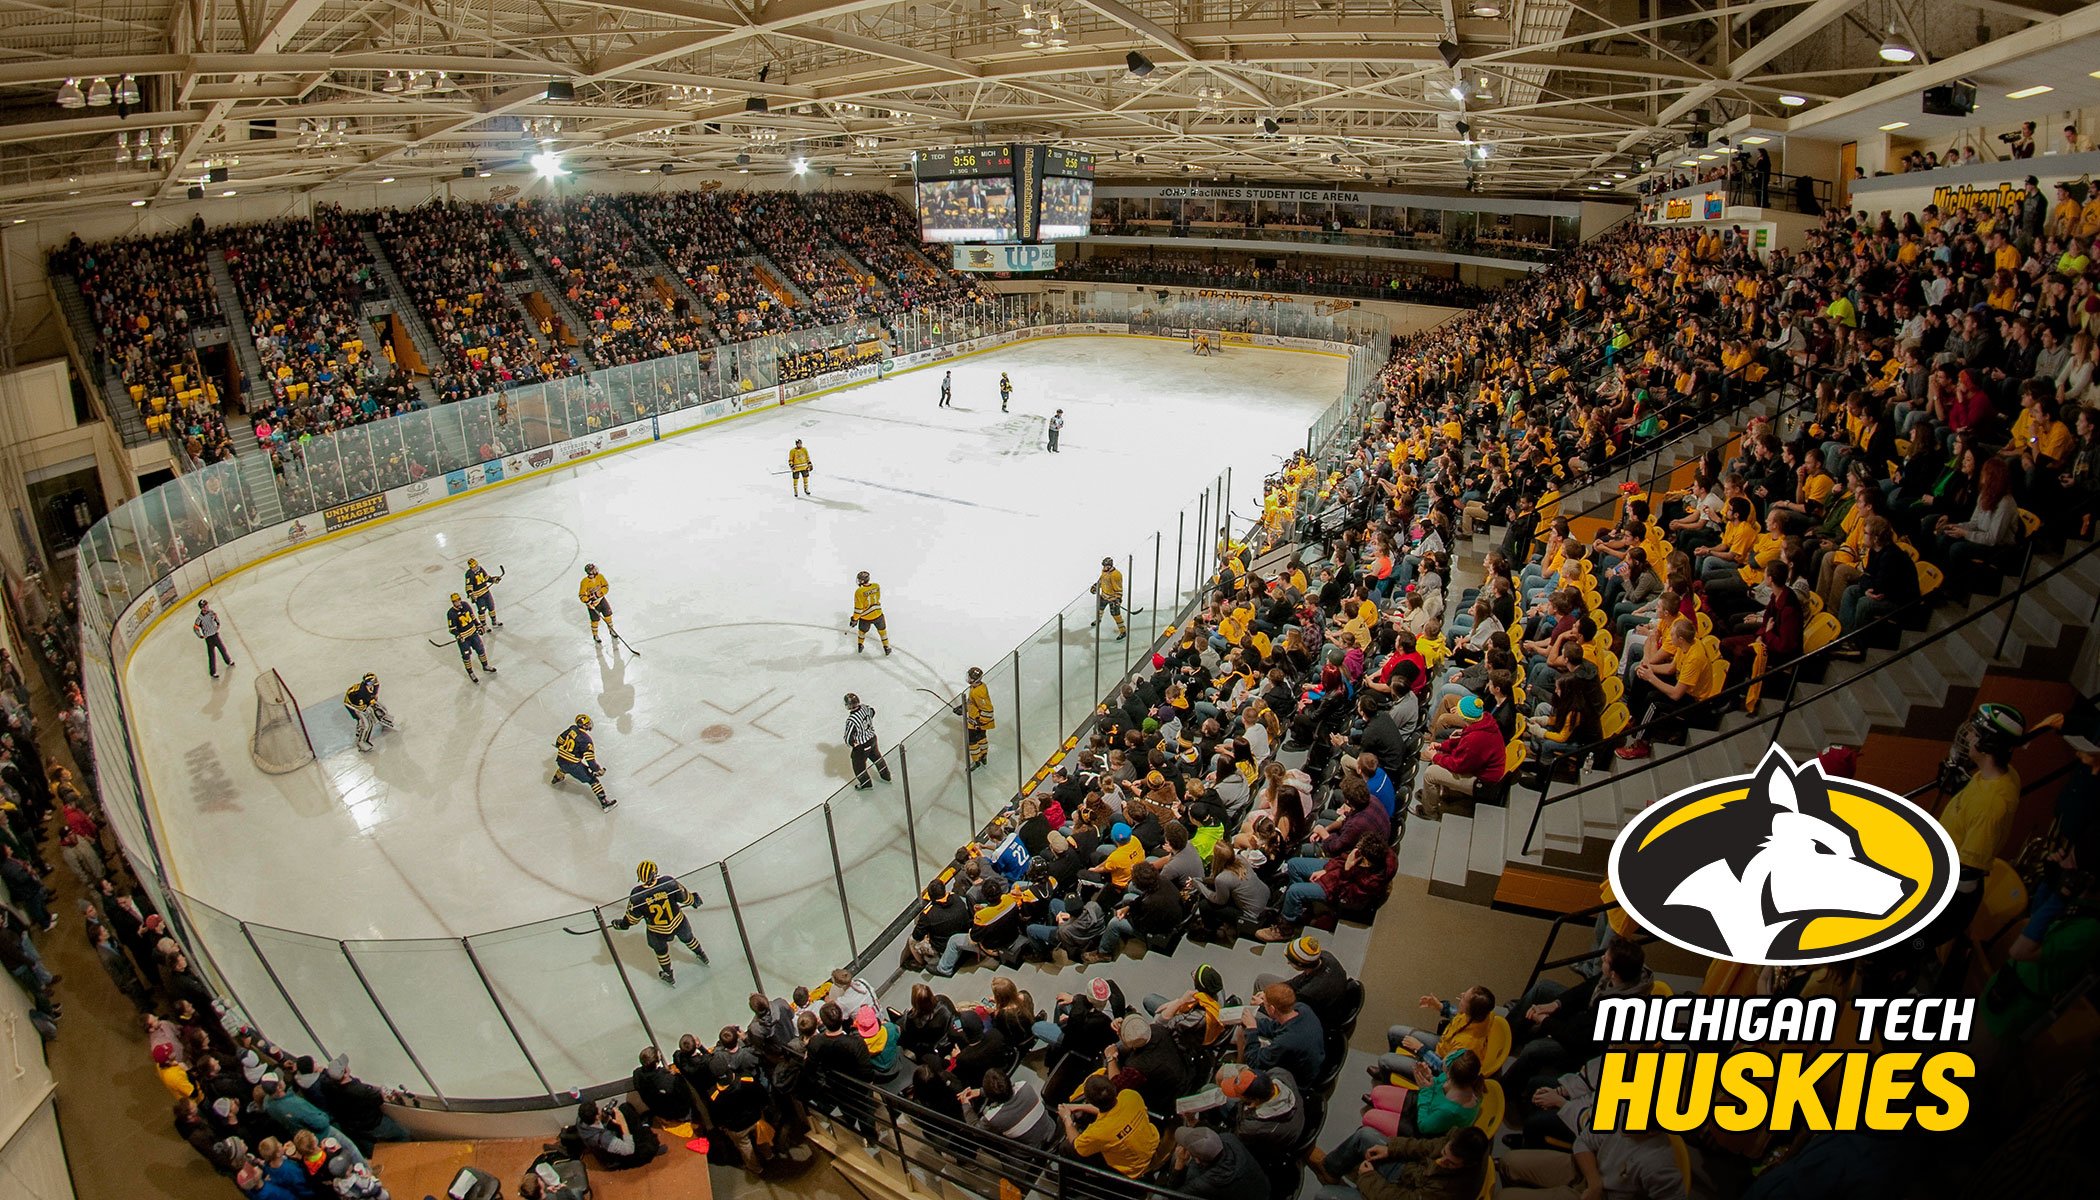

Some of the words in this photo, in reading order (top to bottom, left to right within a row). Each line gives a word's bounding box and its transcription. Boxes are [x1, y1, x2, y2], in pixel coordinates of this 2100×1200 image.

[922, 153, 928, 161] 2
[1002, 147, 1009, 157] 0
[953, 155, 976, 167] 9:56
[1065, 157, 1078, 169] 9:56
[1023, 147, 1034, 238] MichiganTechHuskies.com
[1246, 189, 1295, 200] STUDENT
[1299, 191, 1318, 201] ICE
[1322, 192, 1360, 202] ARENA
[1933, 183, 1998, 217] Michigan
[1998, 182, 2027, 214] Tec
[325, 495, 384, 519] UNIVERSITY
[336, 505, 377, 523] IMAGES
[327, 523, 343, 532] MTU
[475, 572, 486, 586] M
[458, 611, 473, 627] M
[1012, 845, 1030, 867] 22
[648, 898, 674, 925] 21
